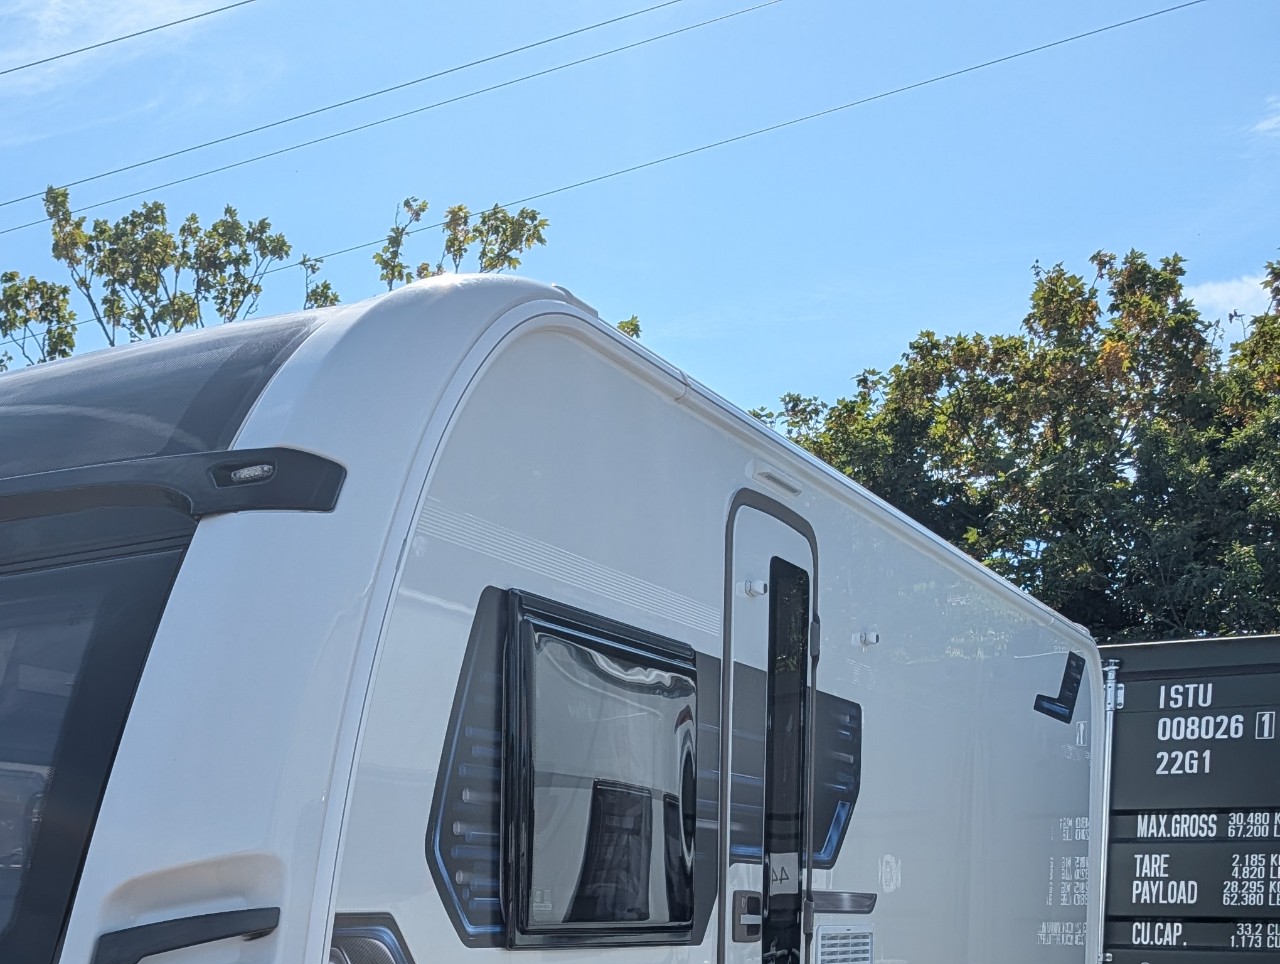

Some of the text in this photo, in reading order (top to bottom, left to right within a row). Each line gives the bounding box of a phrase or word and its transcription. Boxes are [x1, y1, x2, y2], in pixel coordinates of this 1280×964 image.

[1159, 683, 1213, 709] ISTU
[1157, 714, 1244, 741] 008026
[1155, 749, 1211, 775] 22G1
[1136, 814, 1218, 838] MAX.GROSS
[1134, 854, 1170, 877] TARE
[1231, 854, 1266, 867] 2.185
[1131, 880, 1198, 904] PAYLOAD
[1223, 881, 1265, 894] 28.295
[1222, 893, 1264, 906] 62.380
[1236, 923, 1263, 936] 33.2
[1230, 935, 1262, 948] 1.173
